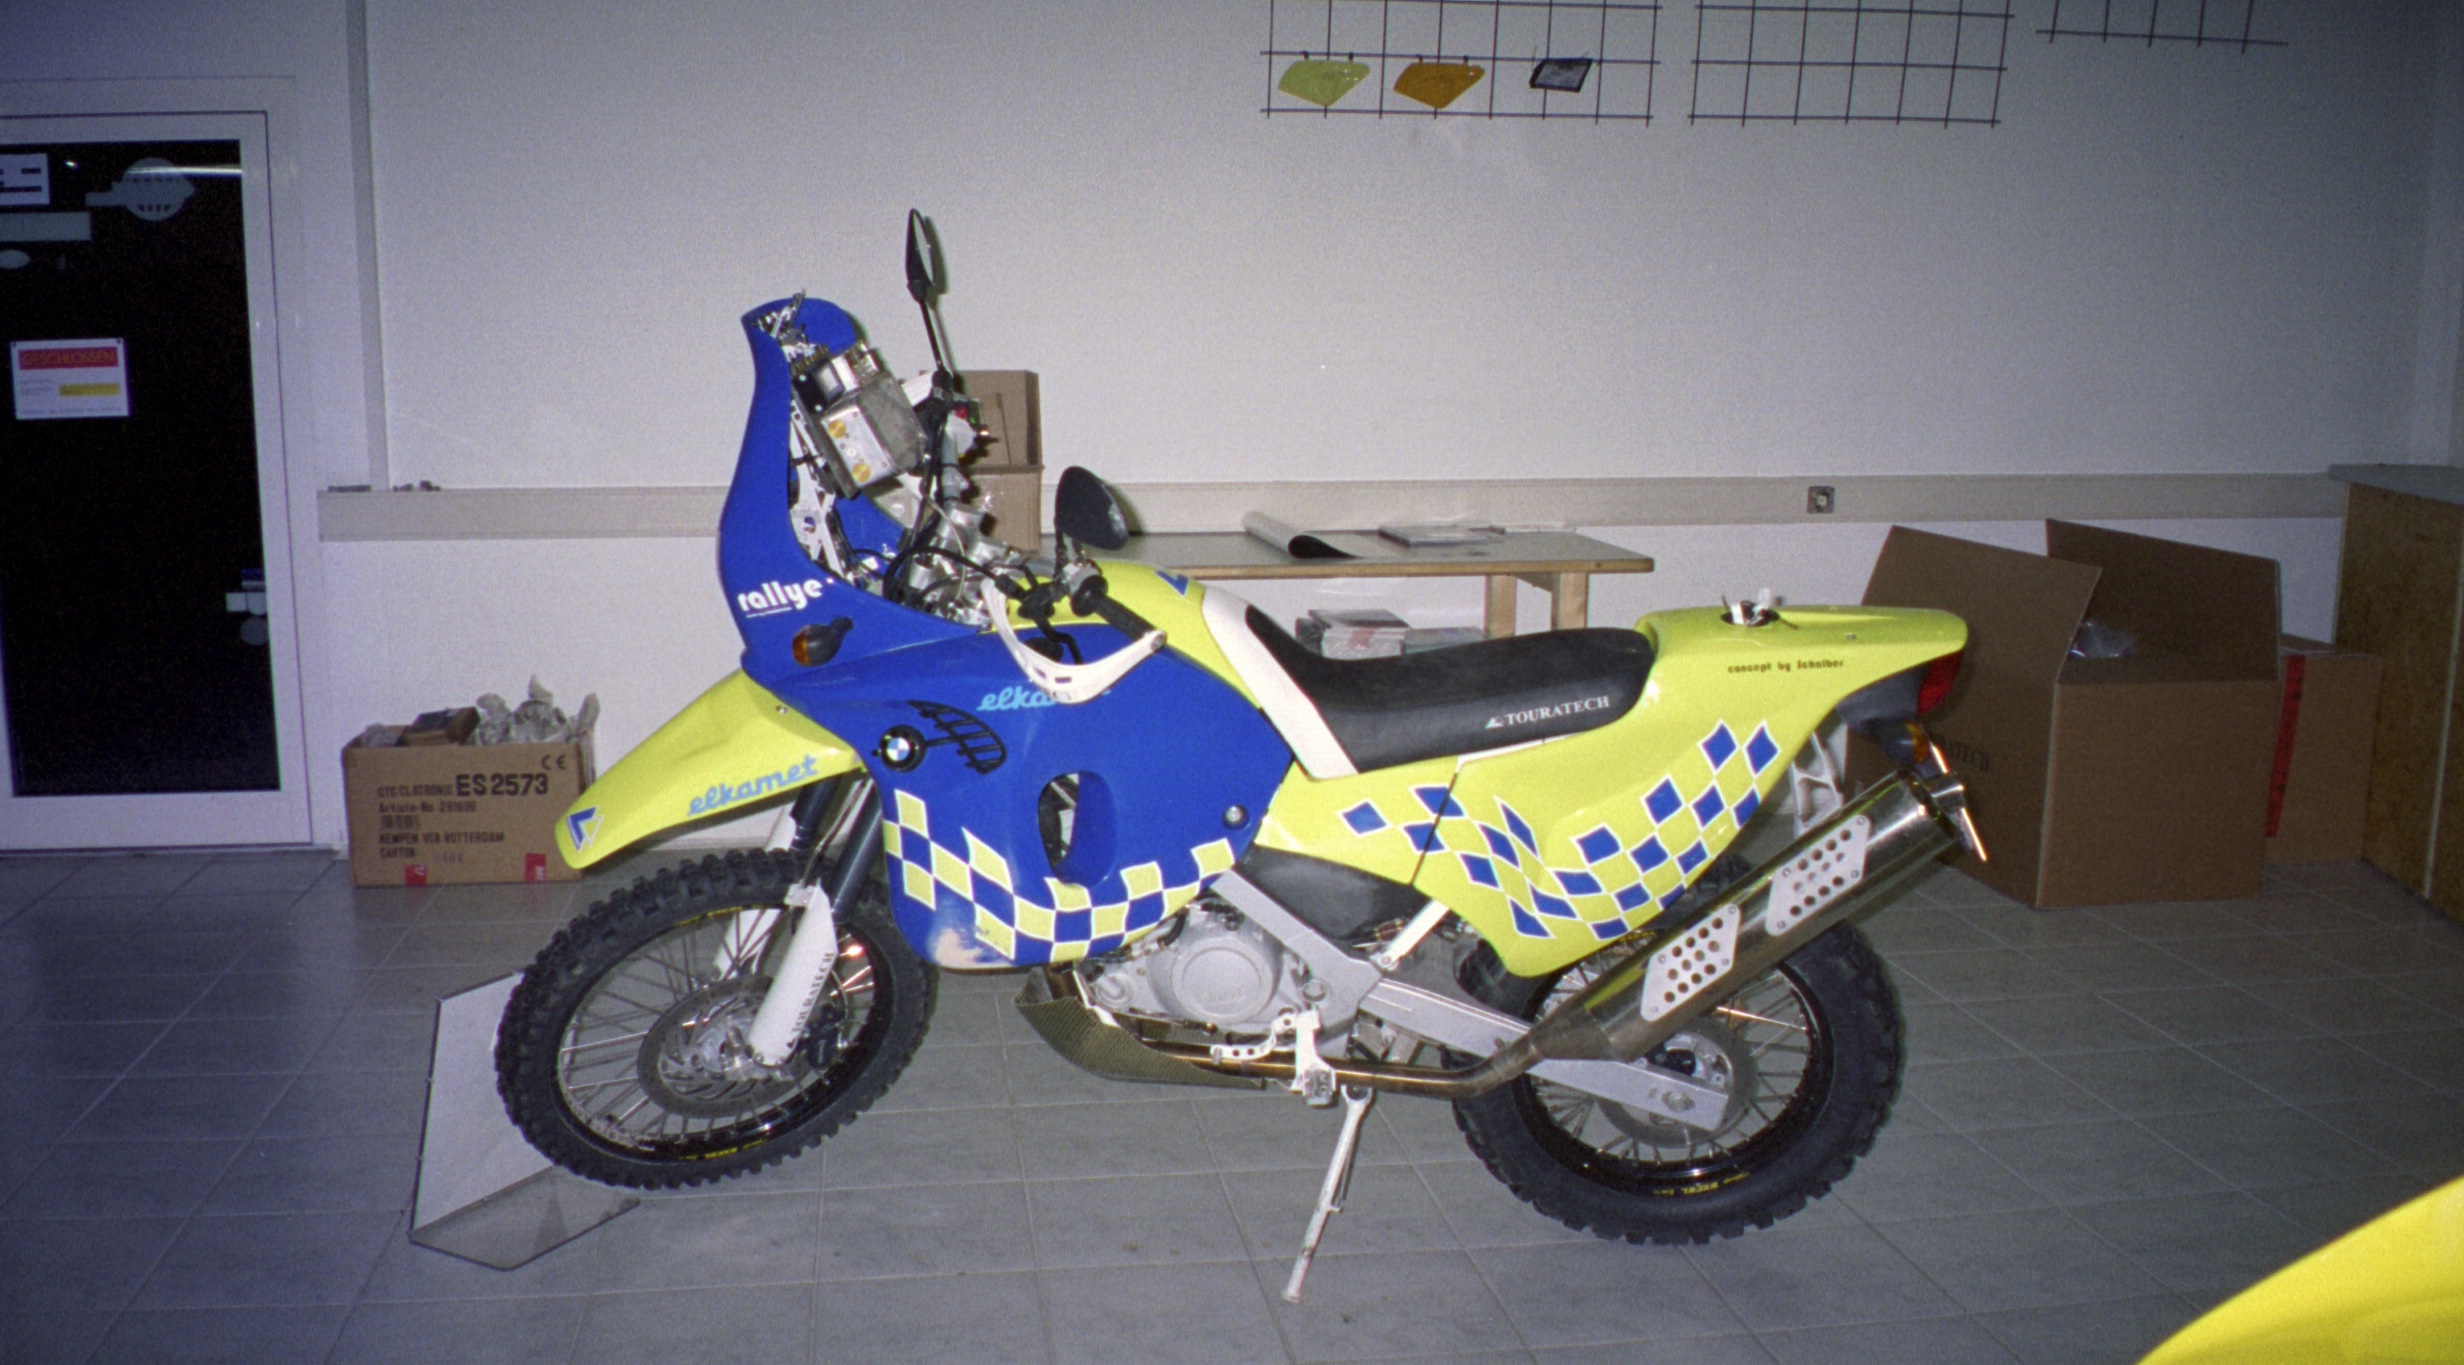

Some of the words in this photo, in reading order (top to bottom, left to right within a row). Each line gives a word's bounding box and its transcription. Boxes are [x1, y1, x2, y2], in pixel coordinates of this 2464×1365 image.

[22, 351, 115, 366] GESCHLOSSEN
[737, 579, 823, 611] rallye
[1727, 662, 1772, 674] concept
[1777, 661, 1791, 673] by
[1505, 695, 1610, 726] TOURATECH
[688, 754, 819, 816] elkamet
[443, 831, 505, 843] ROTTERDAM
